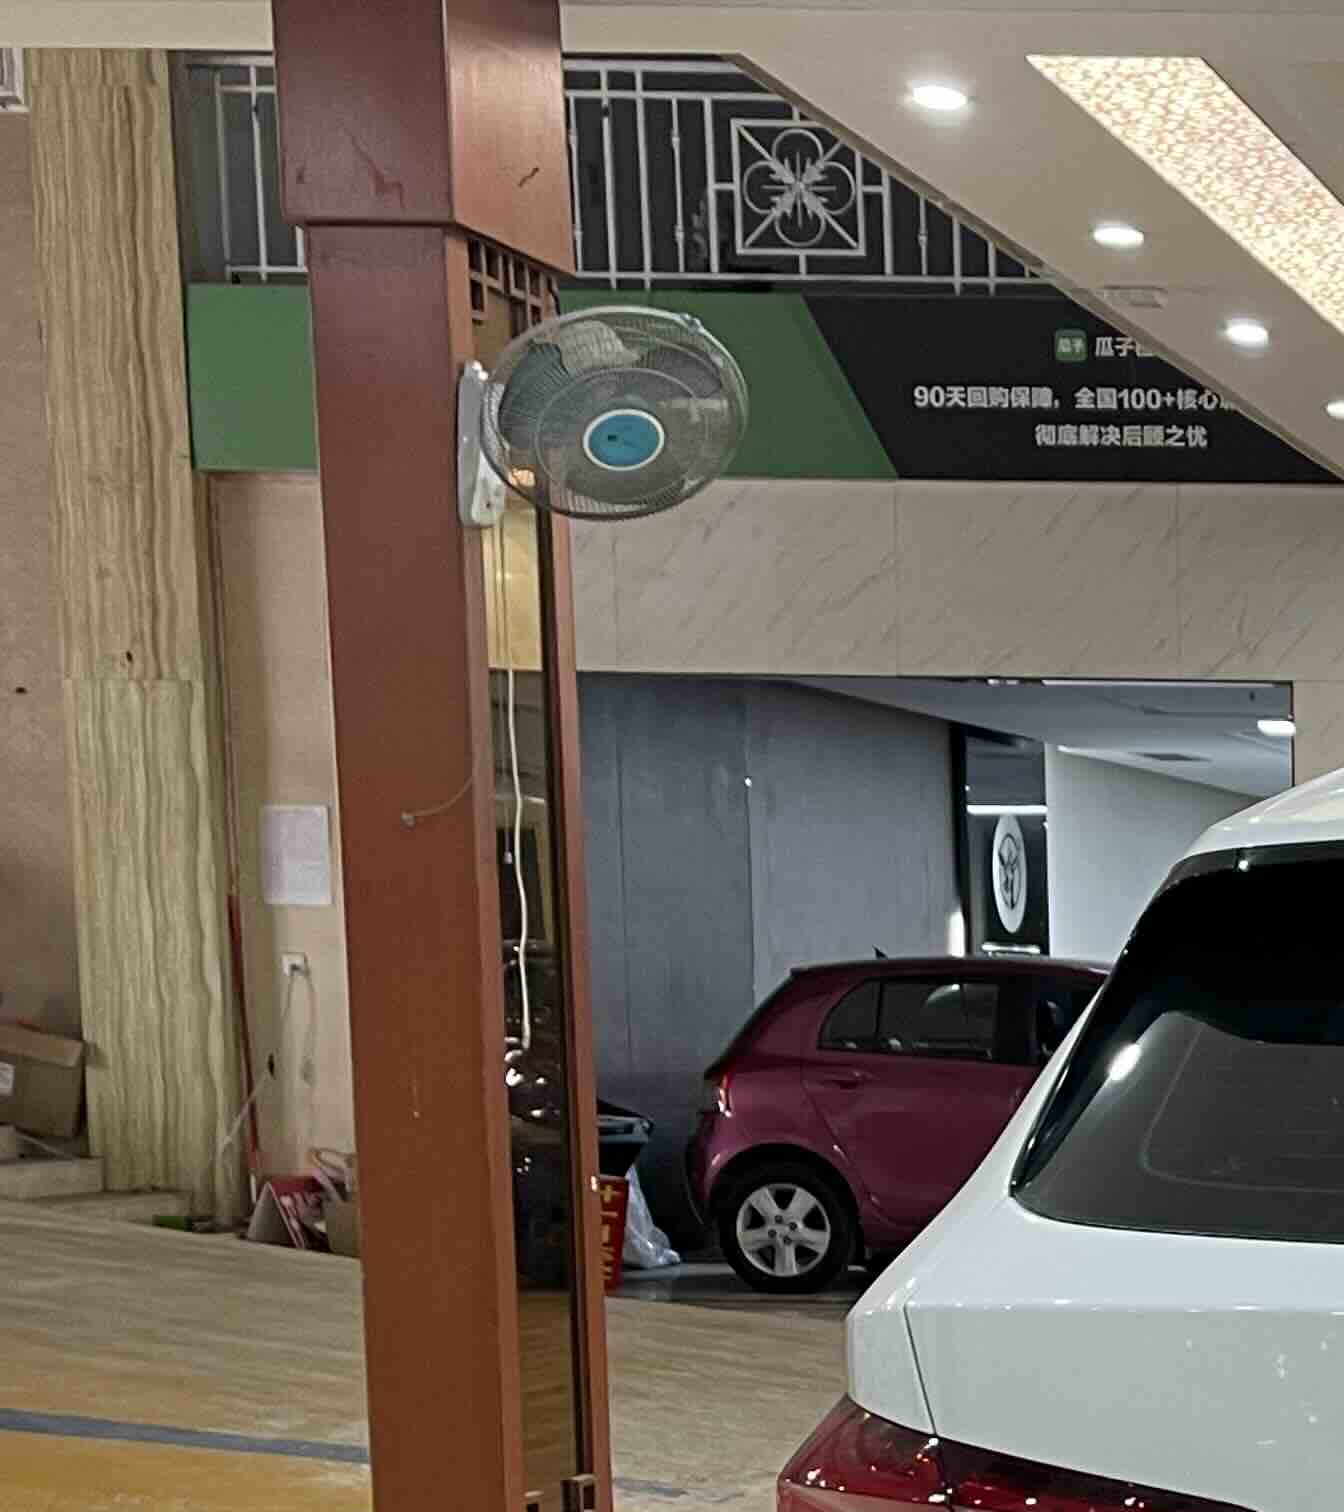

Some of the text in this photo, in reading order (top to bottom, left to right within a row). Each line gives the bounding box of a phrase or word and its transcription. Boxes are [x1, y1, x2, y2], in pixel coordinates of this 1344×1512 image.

[1035, 424, 1208, 448] 彻底解决后顾之忧
